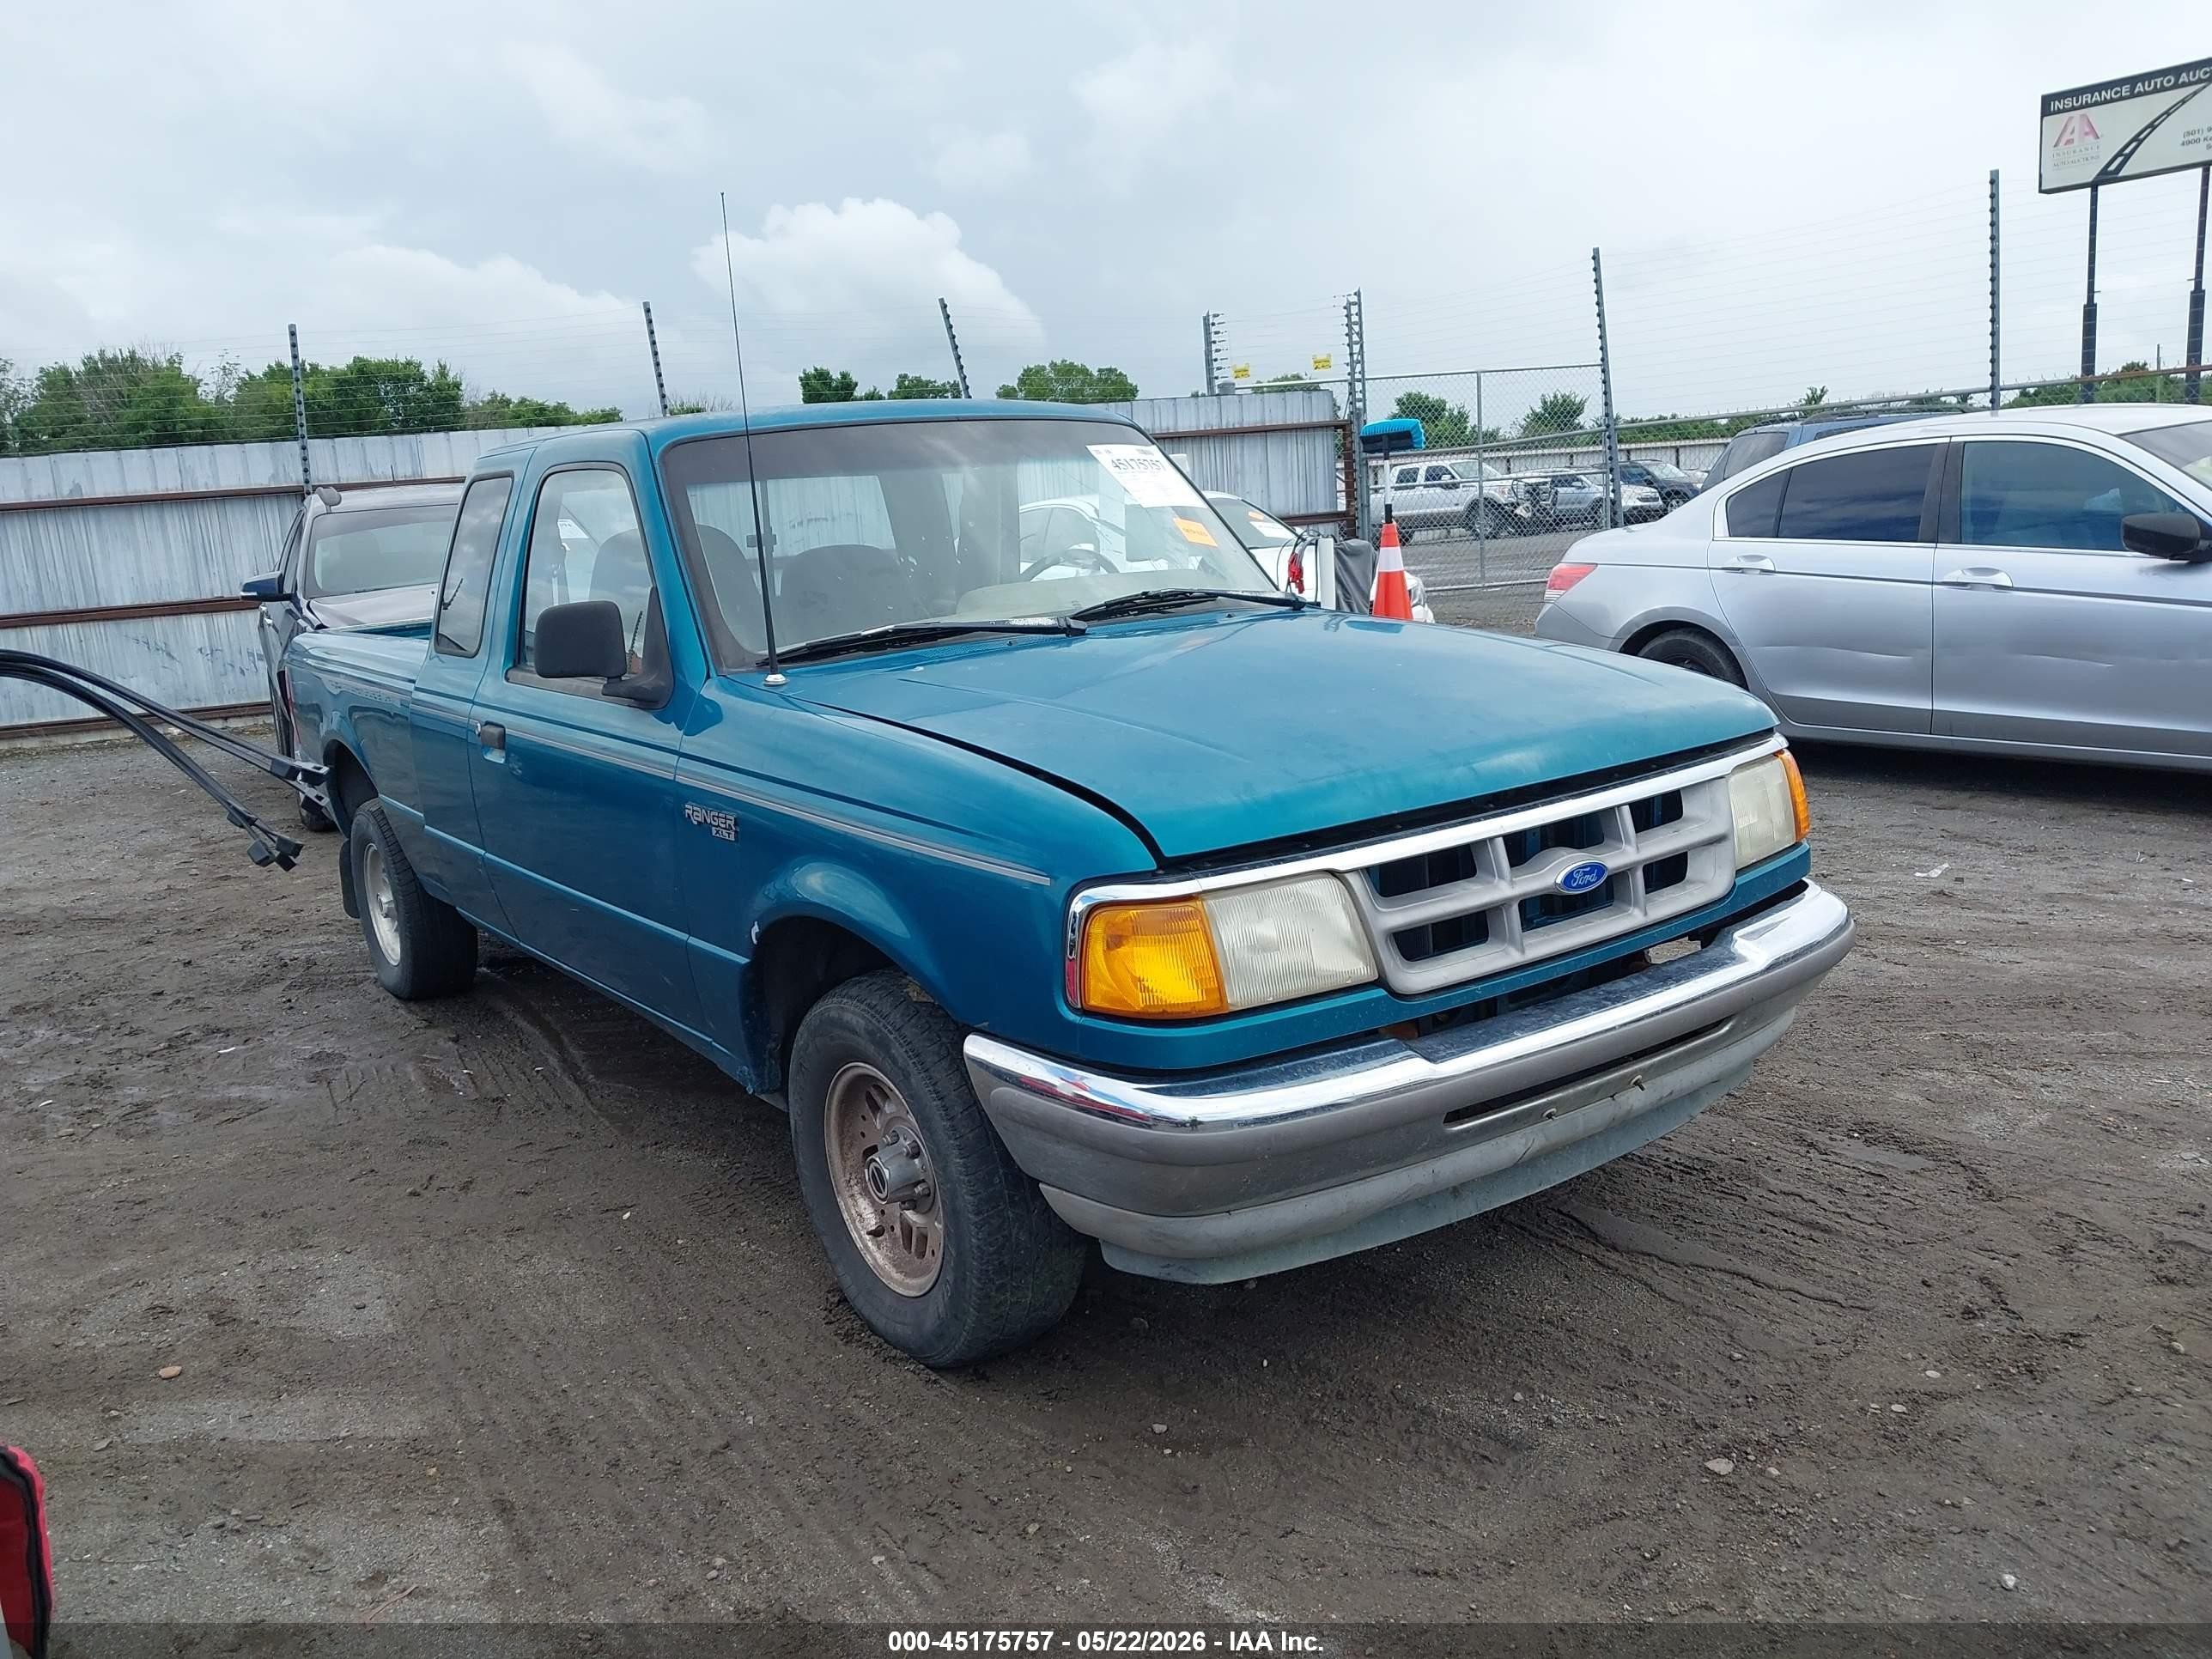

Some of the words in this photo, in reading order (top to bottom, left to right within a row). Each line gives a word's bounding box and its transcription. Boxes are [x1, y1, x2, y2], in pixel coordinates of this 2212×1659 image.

[2050, 85, 2130, 112] INSURANCE
[2134, 76, 2175, 94] AUTO
[1111, 458, 1166, 471] 45175757
[684, 804, 736, 830] RANGER
[714, 828, 732, 839] XLT
[1571, 866, 1597, 887] Ford
